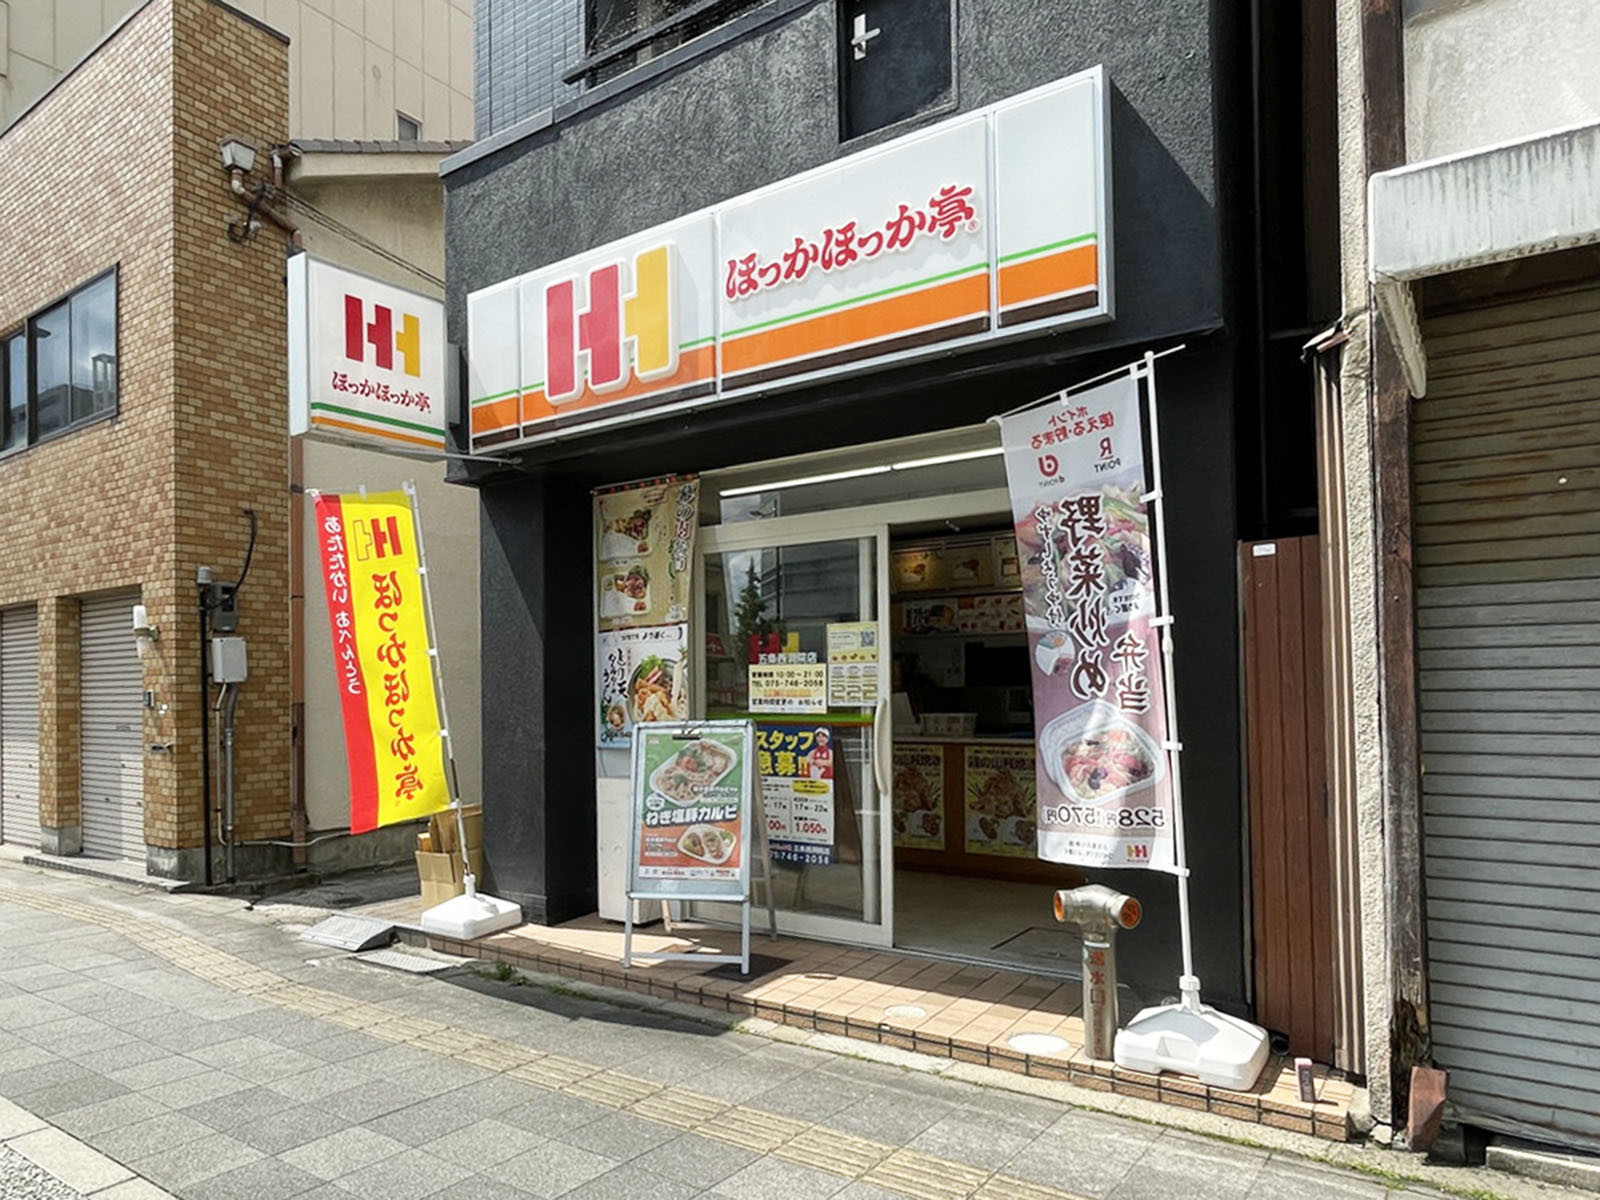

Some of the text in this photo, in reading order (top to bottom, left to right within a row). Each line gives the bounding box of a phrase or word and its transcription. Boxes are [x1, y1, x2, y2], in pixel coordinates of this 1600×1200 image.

[726, 185, 976, 299] ほっかほっか亭
[332, 371, 432, 413] ほっかほっか亭
[756, 729, 814, 751] スタッフ
